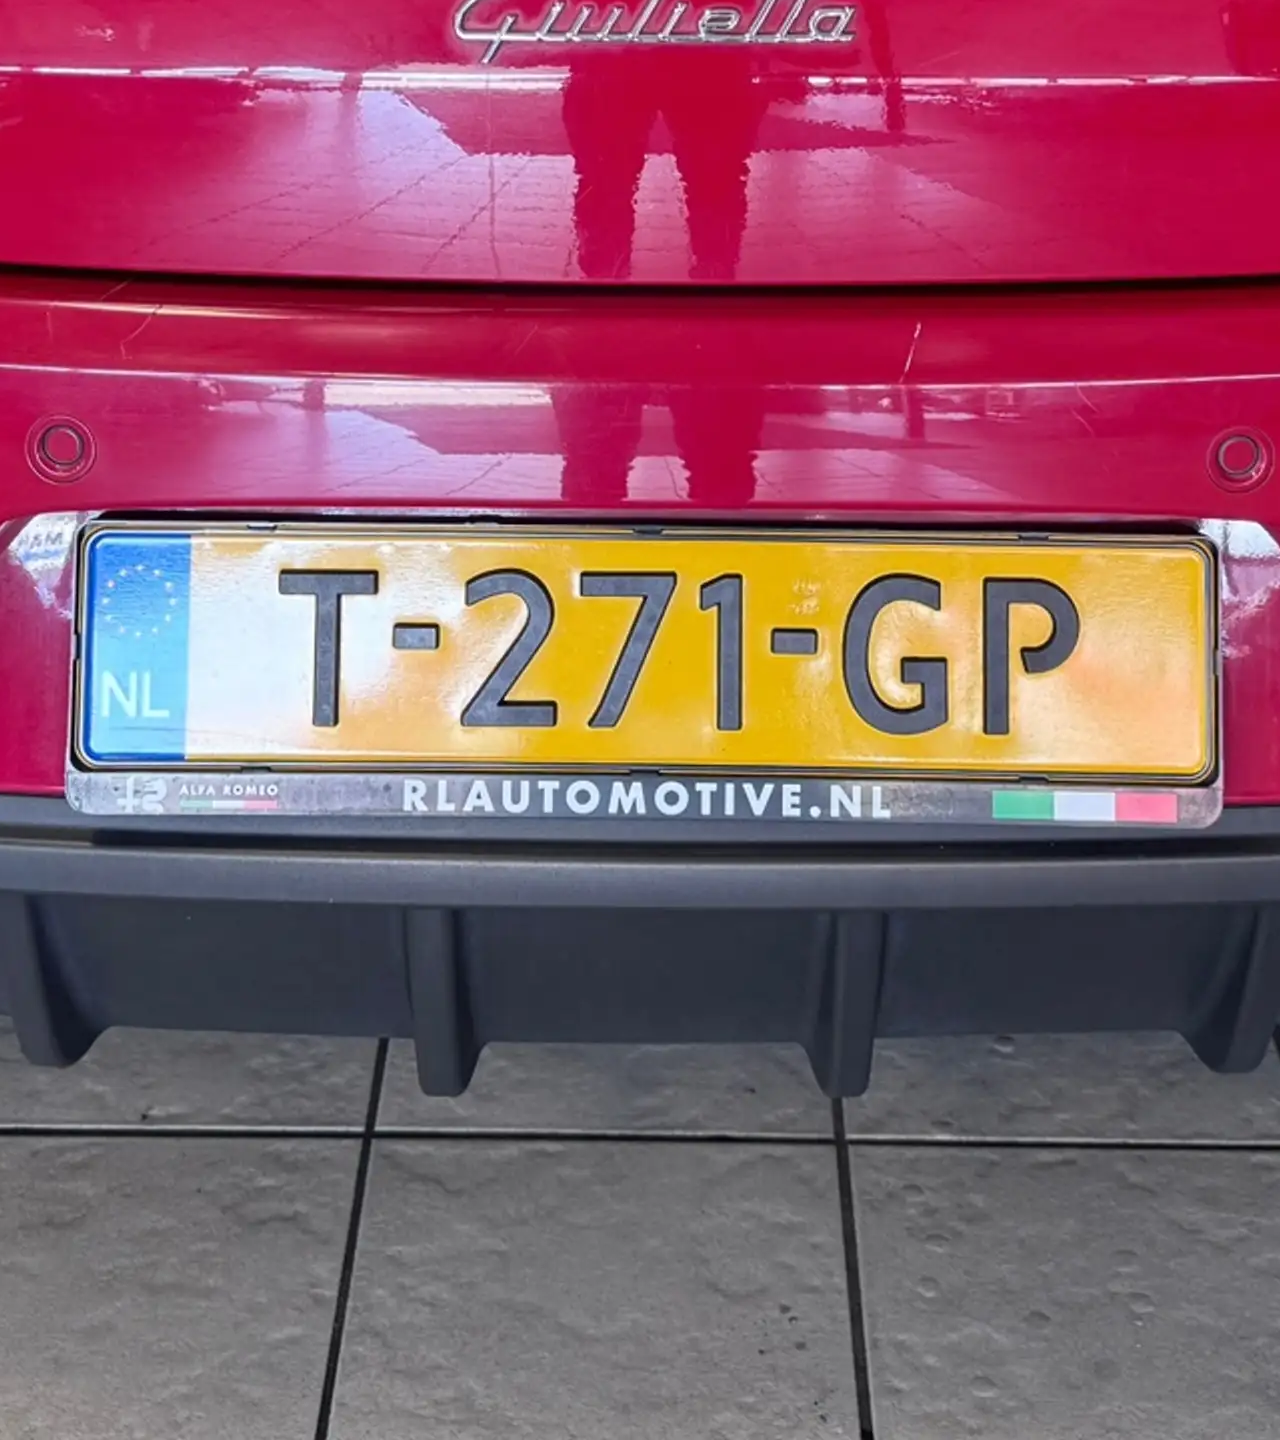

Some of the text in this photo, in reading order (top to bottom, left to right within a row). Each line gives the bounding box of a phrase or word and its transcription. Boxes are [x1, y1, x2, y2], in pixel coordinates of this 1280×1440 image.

[277, 568, 1082, 736] T-271-GP
[100, 670, 172, 720] NL
[180, 784, 279, 796] ALFA ROMEO
[402, 778, 893, 820] RLAUTOMOTIVE.NL
